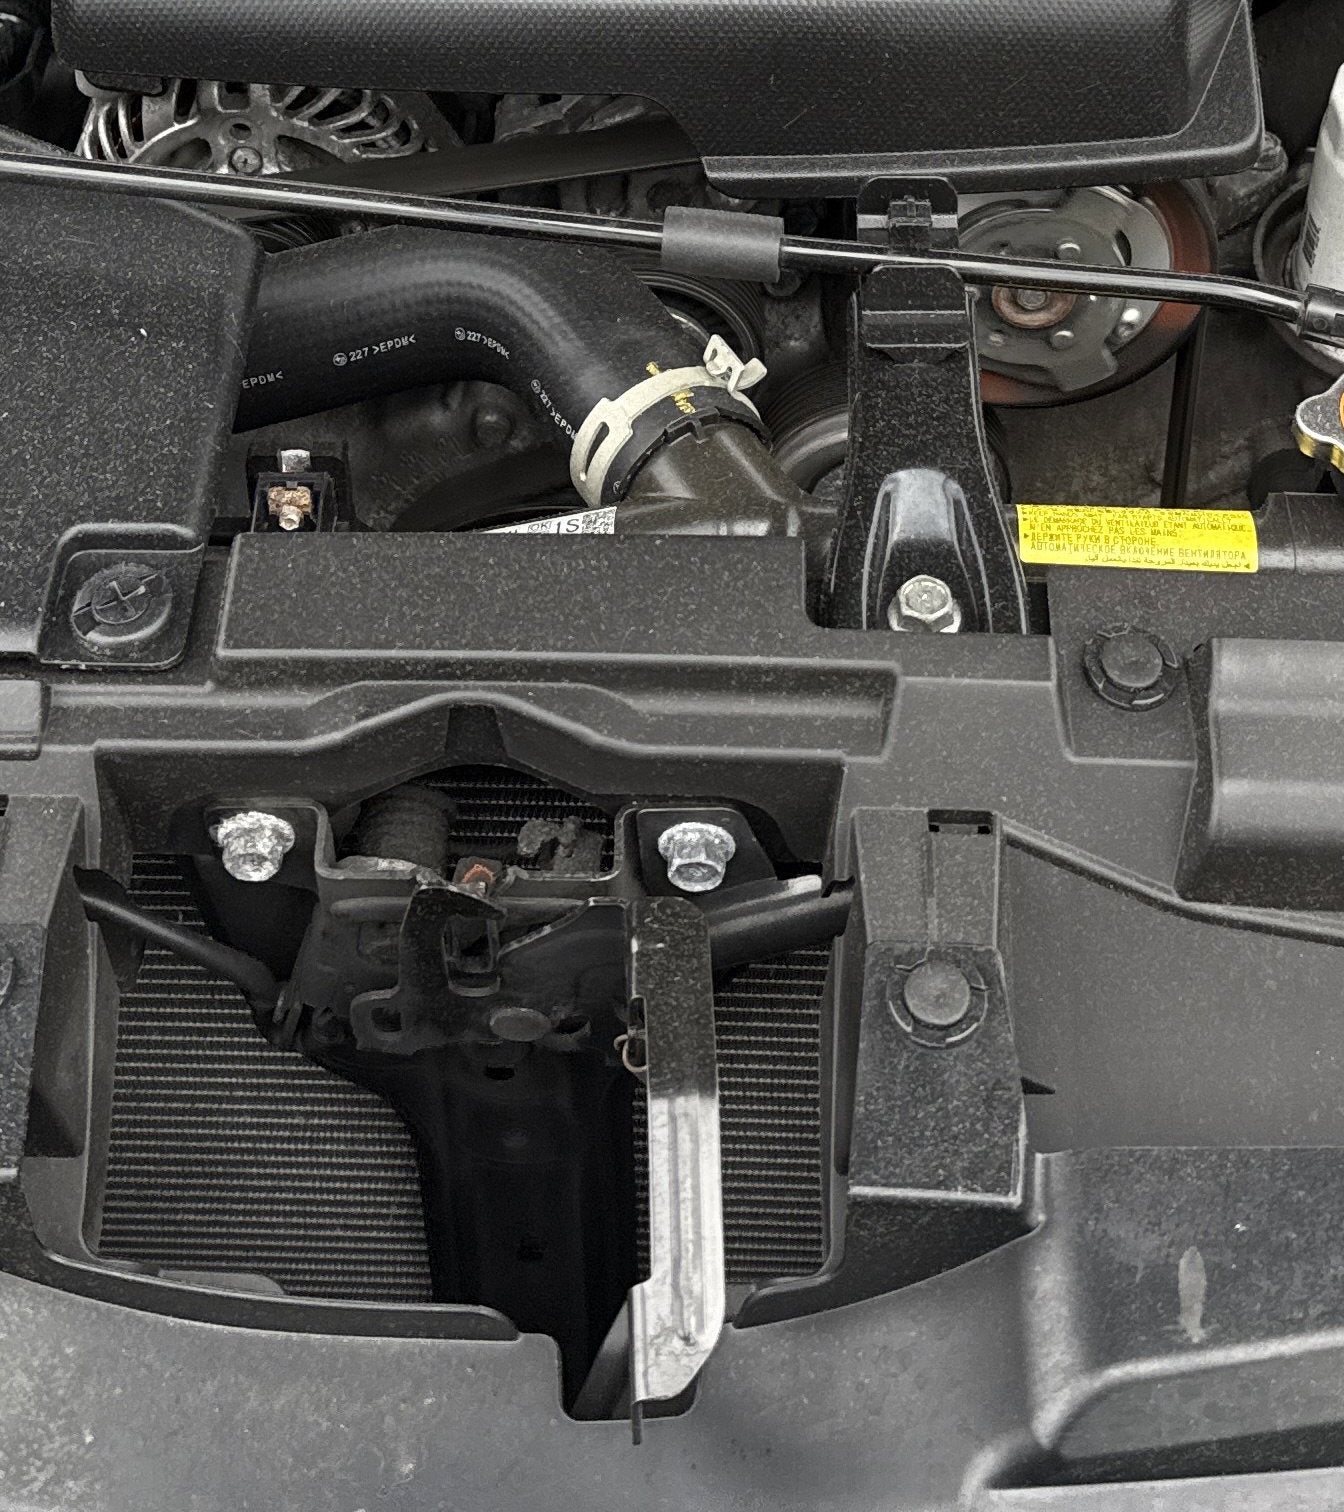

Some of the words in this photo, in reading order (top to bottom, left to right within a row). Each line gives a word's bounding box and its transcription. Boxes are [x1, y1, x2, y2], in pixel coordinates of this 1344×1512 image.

[349, 347, 369, 363] 227
[1108, 526, 1125, 535] PAS
[1129, 527, 1146, 536] LES
[1031, 533, 1073, 542] ДЕРЖИТЕ
[1076, 534, 1101, 544] РУКИ
[1030, 542, 1115, 553] АВТОМАТИЧЕСКОЕ
[1120, 545, 1175, 556] ВКЛЮЧЕНИЕ
[1178, 547, 1247, 560] ВЕНТИЛЯТОРА
